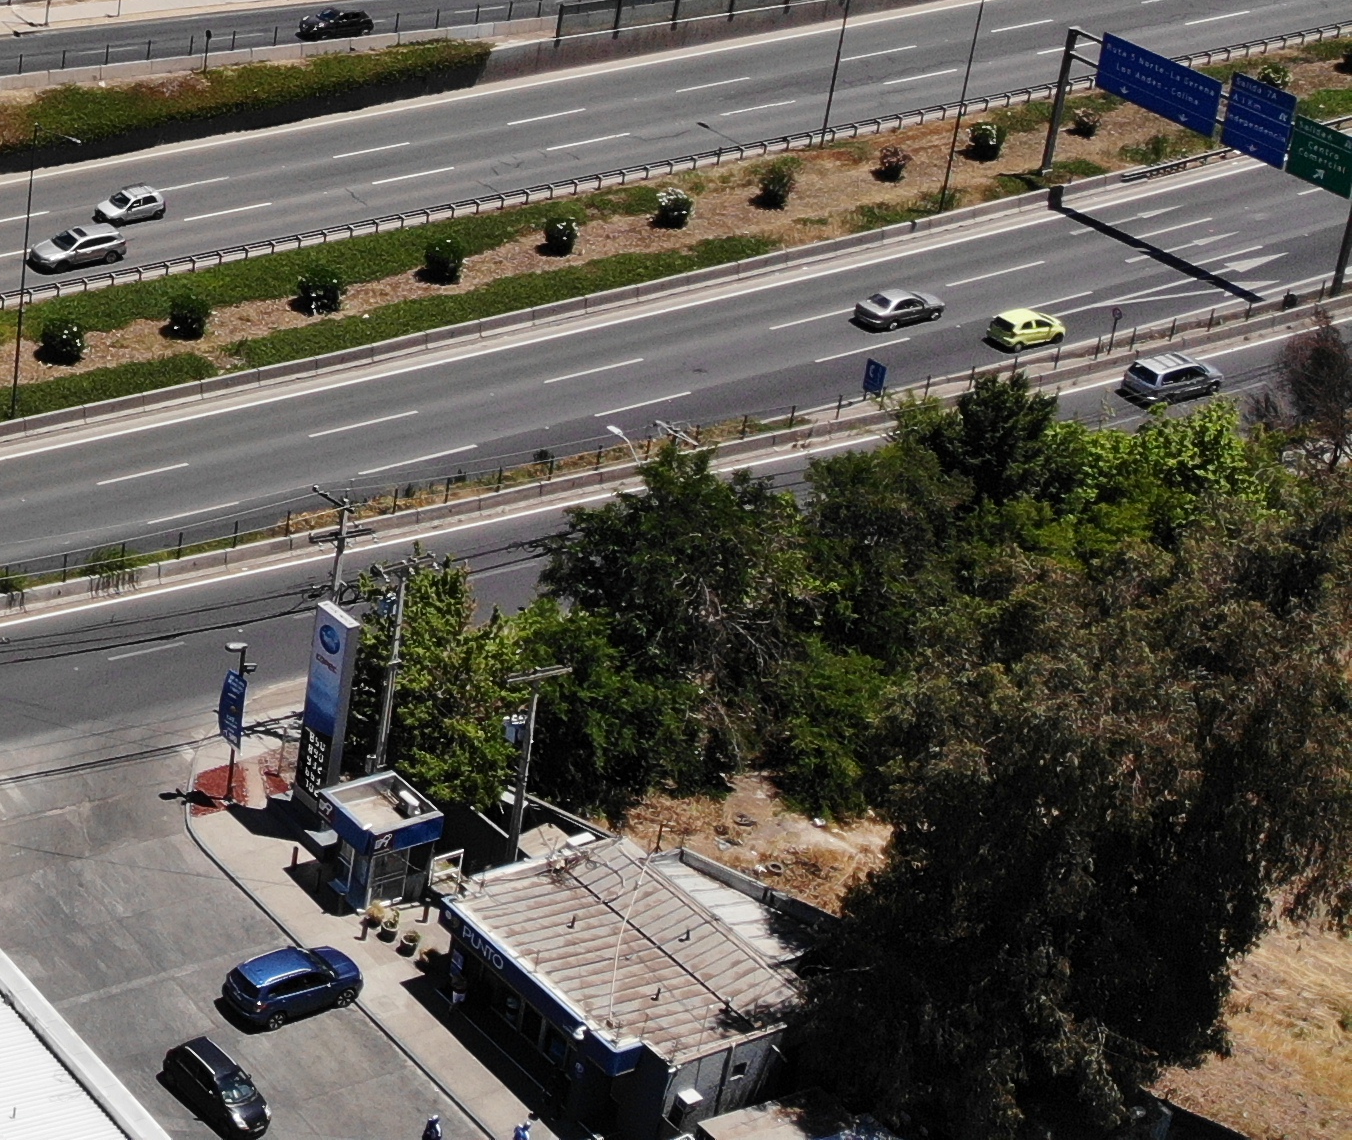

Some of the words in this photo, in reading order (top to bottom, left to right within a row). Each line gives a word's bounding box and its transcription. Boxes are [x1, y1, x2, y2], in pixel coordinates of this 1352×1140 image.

[1135, 72, 1162, 88] Andes
[1171, 87, 1199, 105] Colina
[1184, 77, 1215, 97] Serena
[1236, 77, 1262, 93] Salida
[1267, 90, 1277, 99] 7A
[1299, 121, 1326, 138] Salida
[1299, 148, 1346, 174] Comercial
[1308, 141, 1340, 160] Centro
[462, 925, 504, 970] PUNTO
